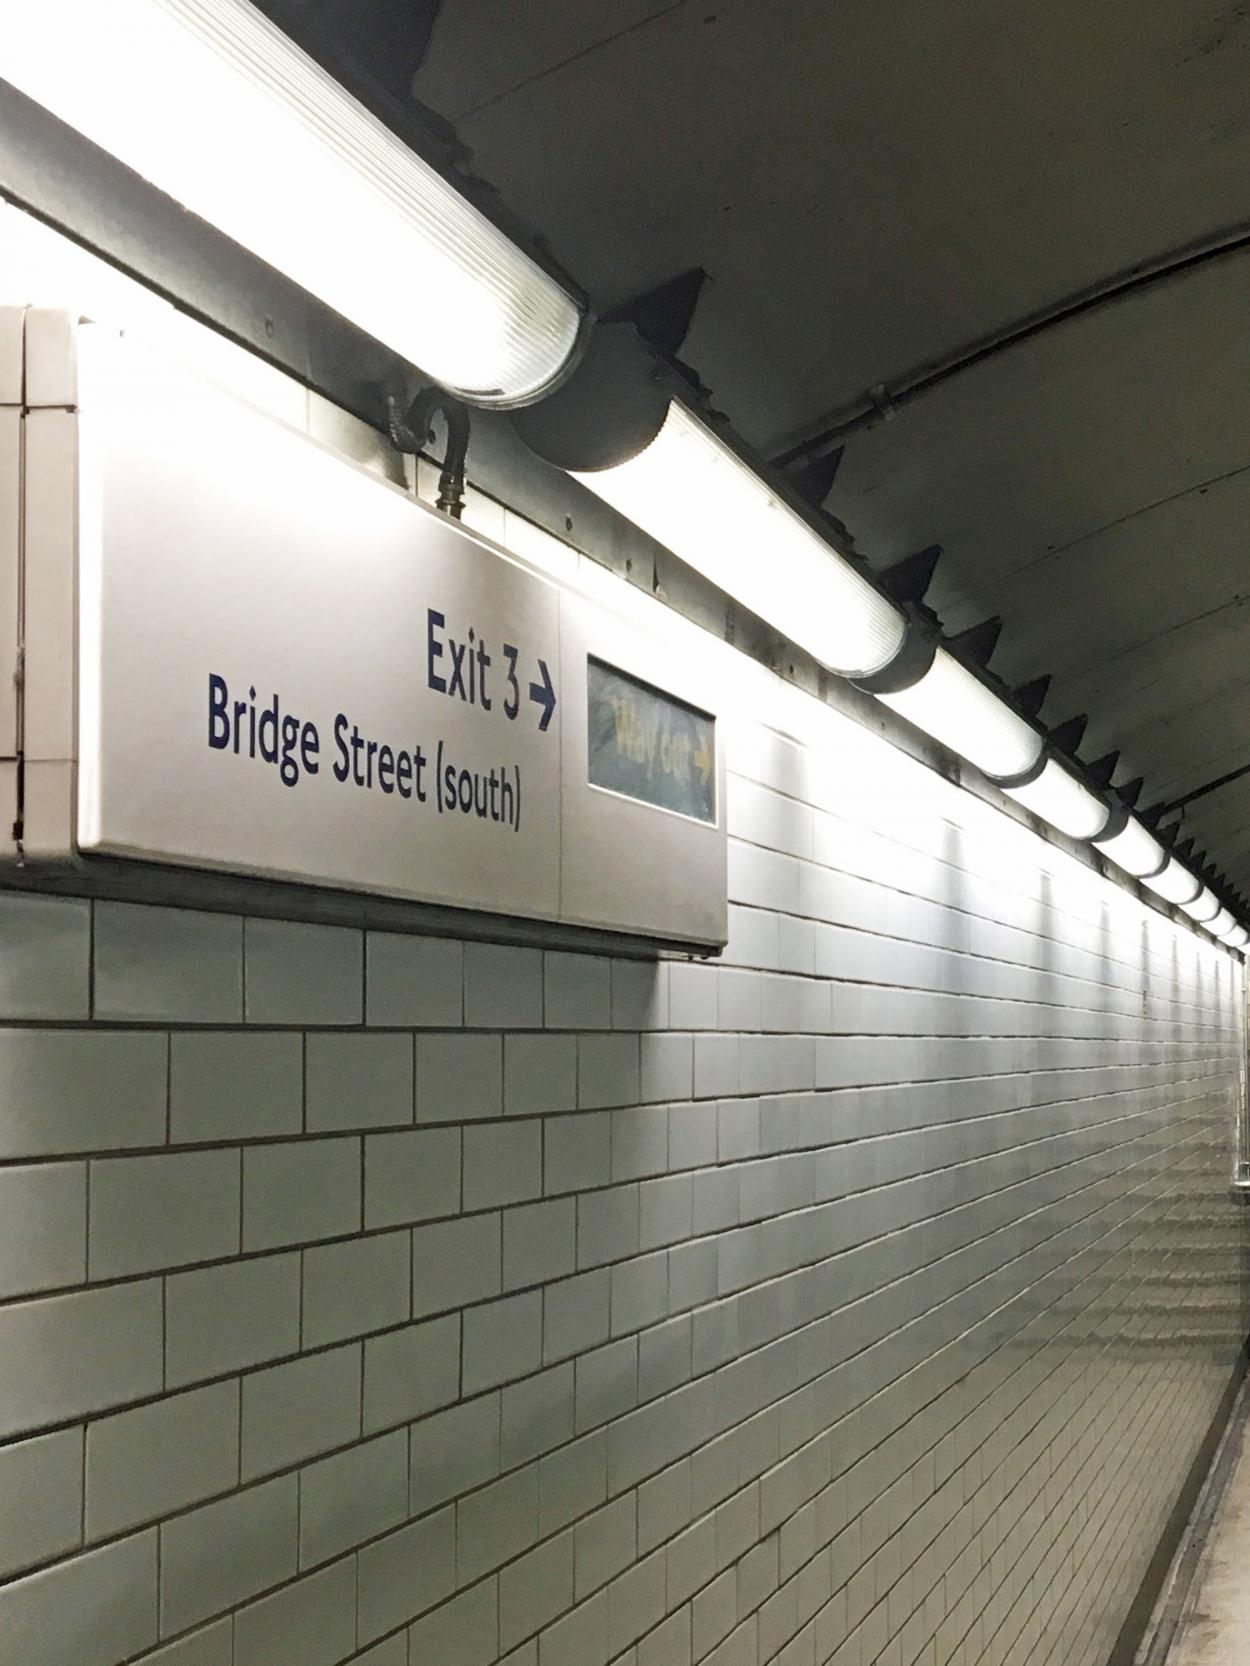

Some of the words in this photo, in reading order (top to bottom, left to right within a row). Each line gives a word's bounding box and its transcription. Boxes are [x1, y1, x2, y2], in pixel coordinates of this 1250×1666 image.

[427, 608, 492, 712] Exit
[502, 642, 521, 721] 3
[208, 672, 320, 788] Bridge
[332, 713, 428, 804] Street
[436, 739, 522, 834] (south)
